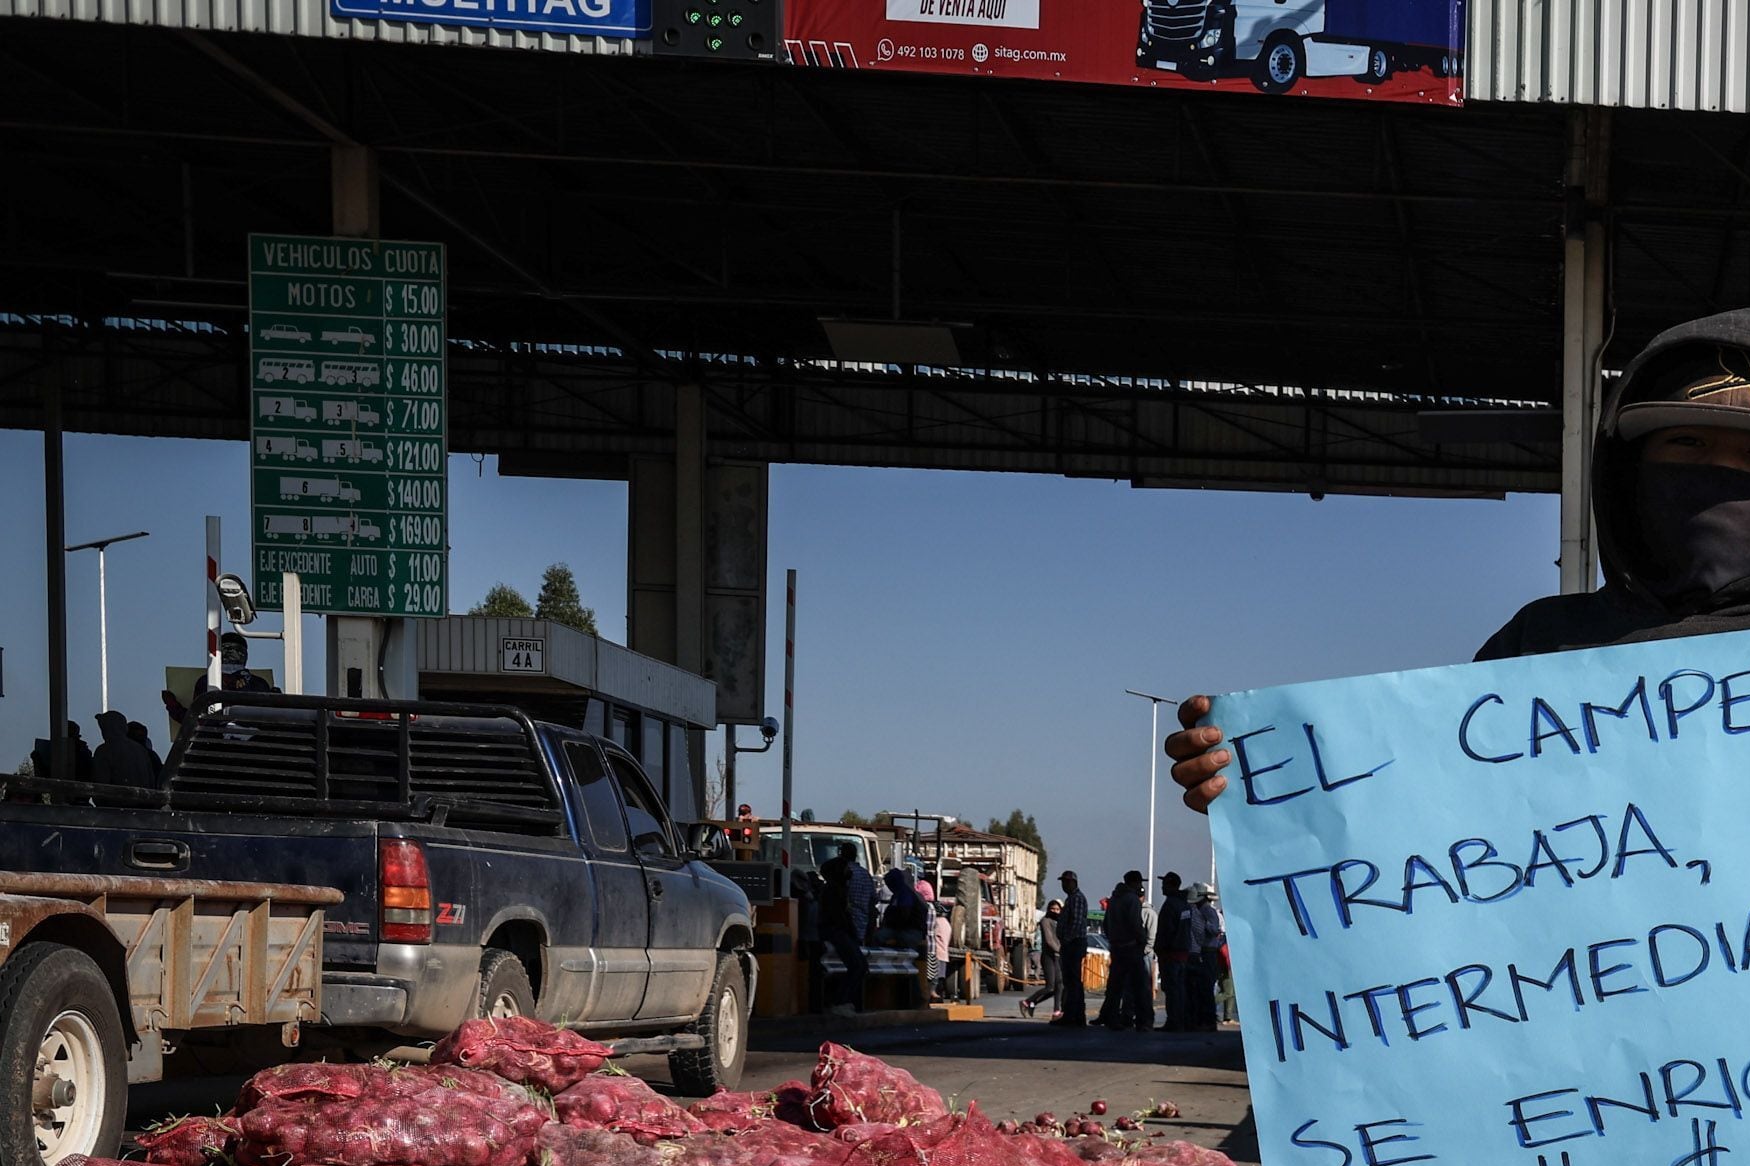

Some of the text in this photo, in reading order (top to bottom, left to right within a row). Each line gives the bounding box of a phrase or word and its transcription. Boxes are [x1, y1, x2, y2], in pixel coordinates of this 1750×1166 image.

[920, 0, 934, 15] DE
[939, 0, 974, 17] VENTA
[897, 45, 964, 60] 492 103 1078
[994, 46, 1067, 62] sitag.com.mx
[263, 242, 439, 274] VEHICULOS CUOTA
[288, 283, 438, 315] MOTOS $ 15.00
[386, 322, 438, 353] $ 30.00
[282, 362, 438, 393] 2 3 $ 46.00
[275, 400, 439, 430] 2 3 $ 71.00
[266, 440, 439, 471] 4 5 $ 121.00
[302, 479, 440, 509] 6 $ 140.00
[265, 515, 440, 545] 7 8 $ 169.00
[260, 550, 440, 582] EJE EXCEDENTE AUTO $ 11.00
[261, 582, 440, 613] EJE EDENTE CARGA $ 29.00
[505, 641, 543, 652] CARRIL
[1229, 721, 1395, 806] EL
[1244, 802, 1711, 938] TRABAJA,
[435, 903, 466, 924] Z71
